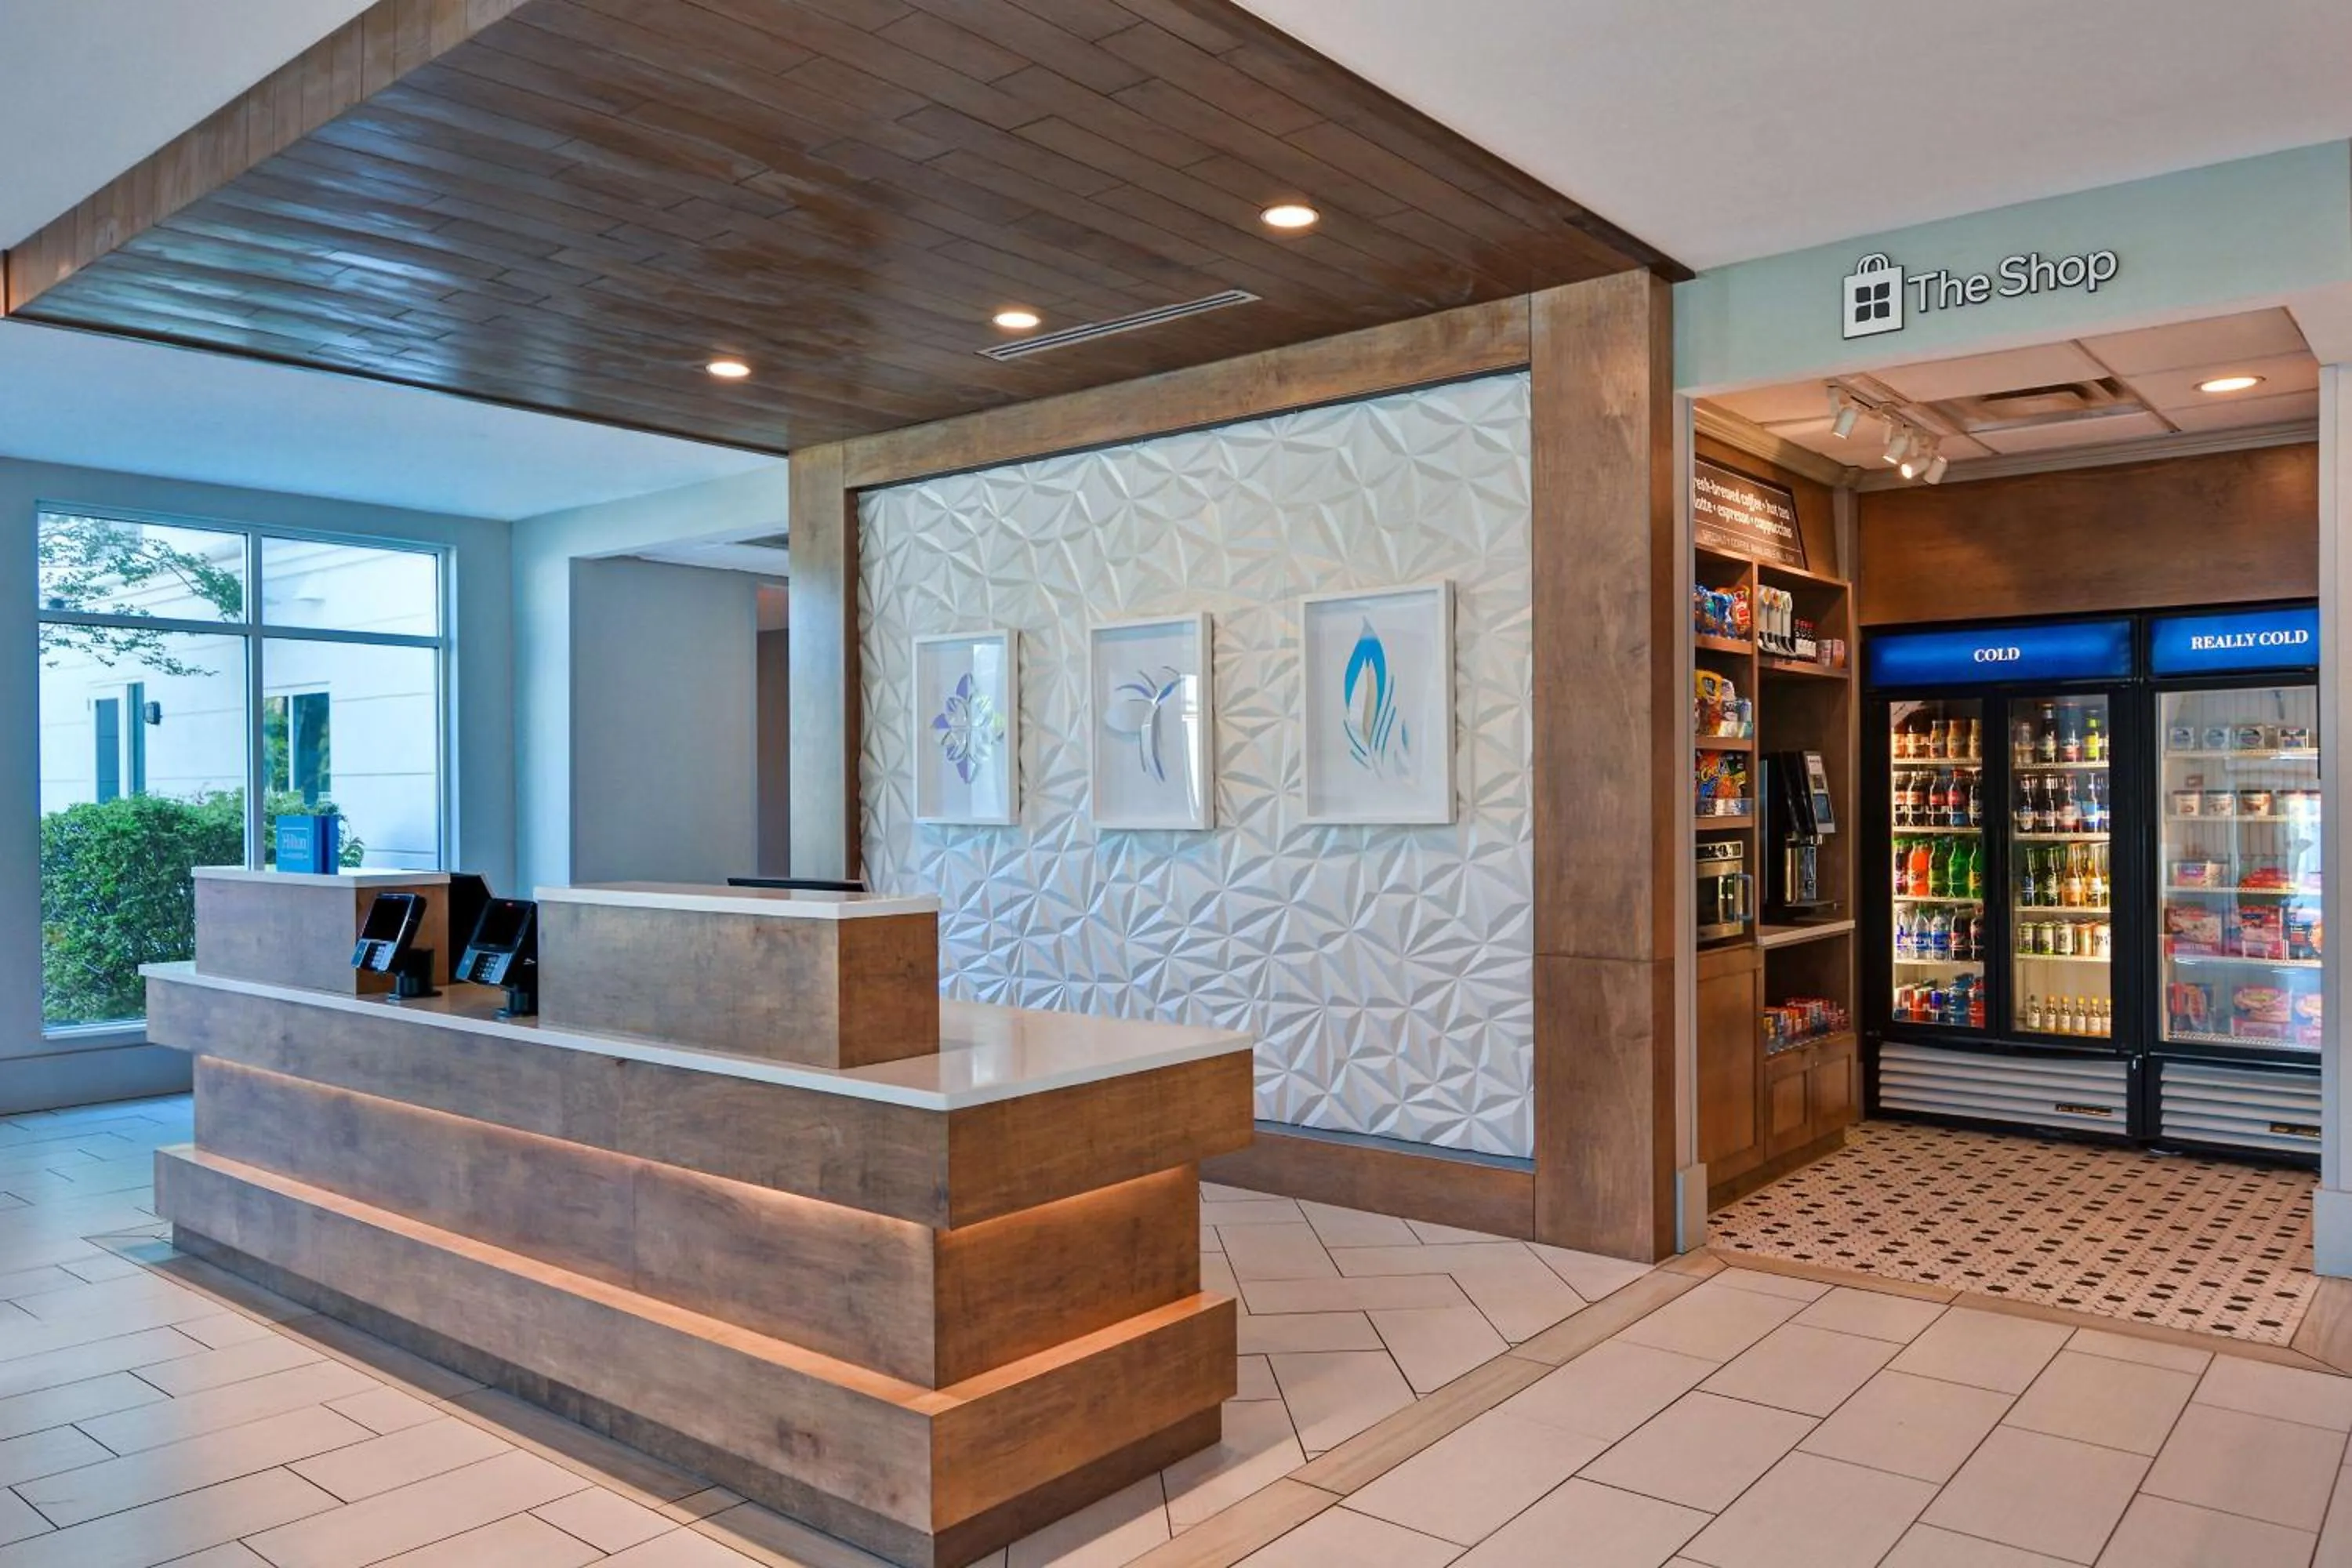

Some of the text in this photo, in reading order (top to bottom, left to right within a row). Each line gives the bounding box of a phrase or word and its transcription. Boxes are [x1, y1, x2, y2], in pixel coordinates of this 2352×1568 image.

[1907, 250, 2118, 313] The Shop
[1693, 476, 1740, 504] resh-brewed
[2190, 630, 2309, 650] REALLY COLD
[1973, 647, 2020, 662] COLD
